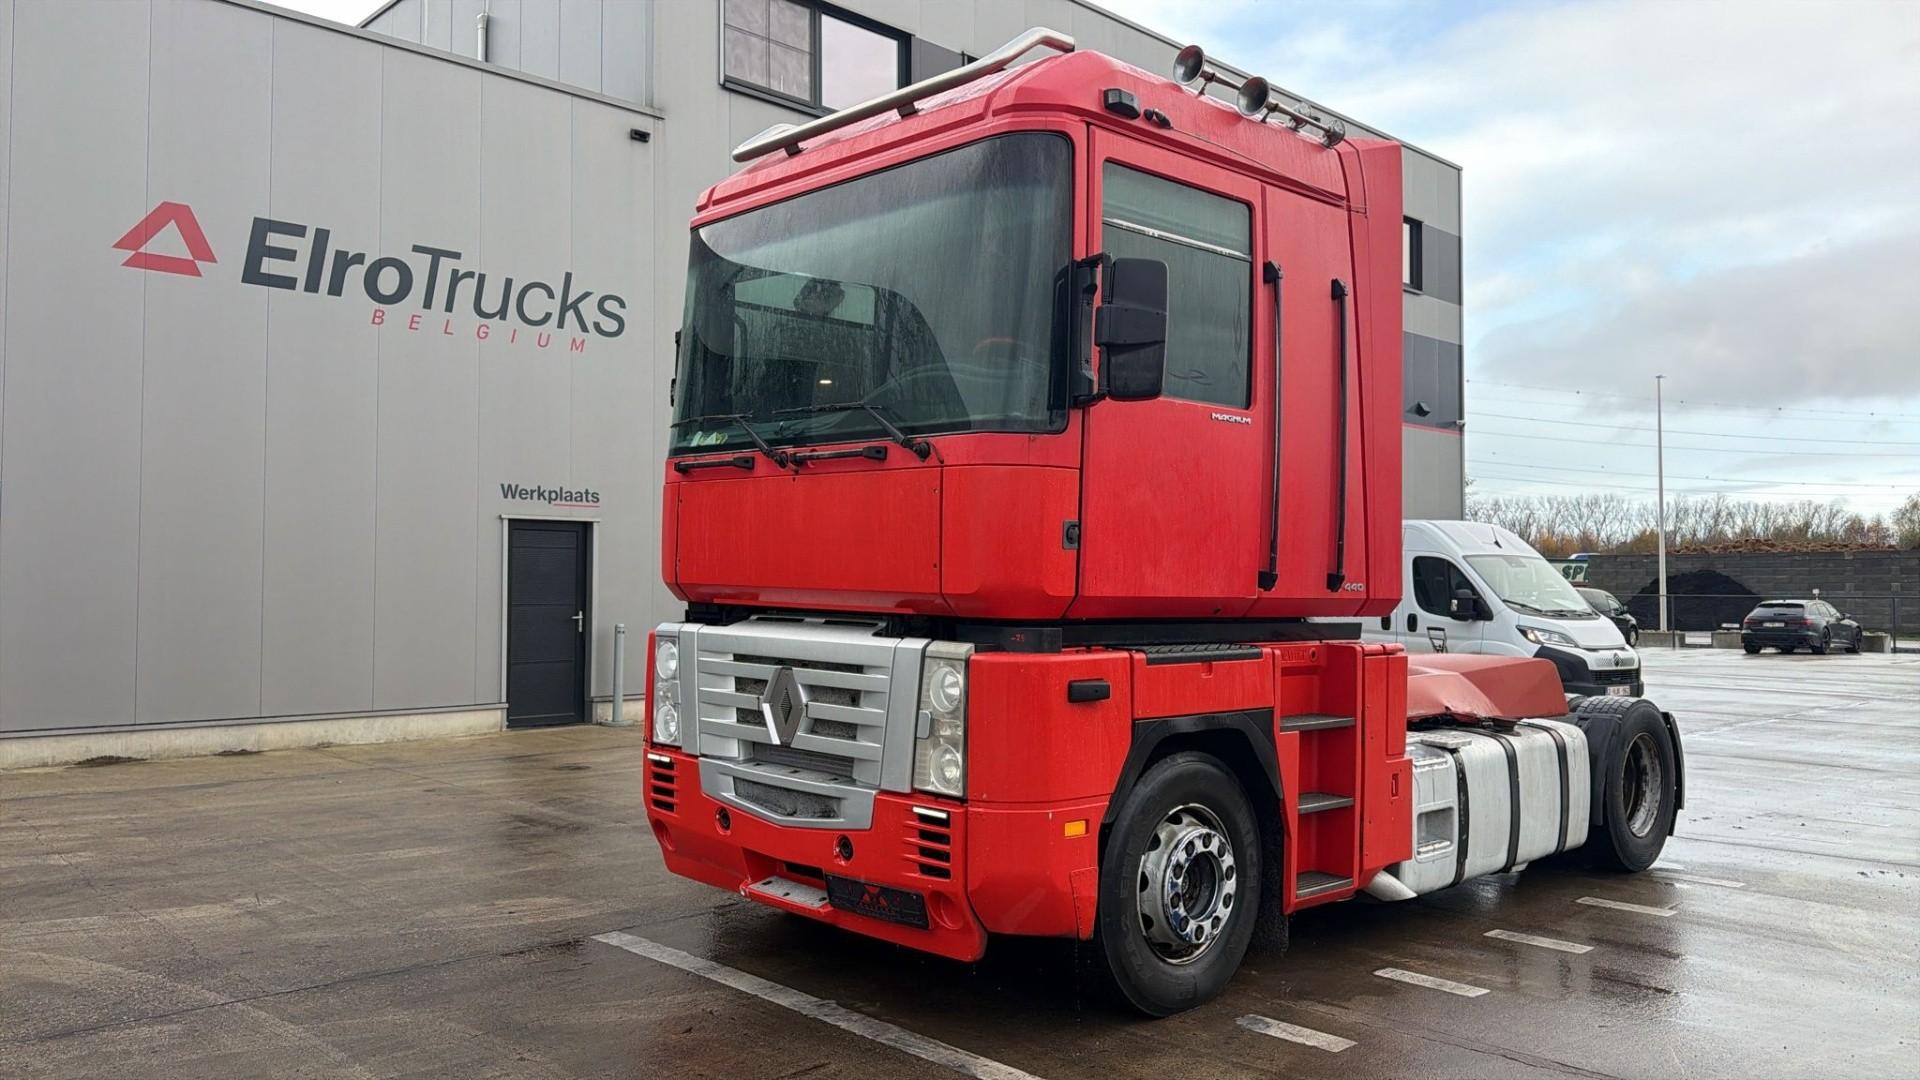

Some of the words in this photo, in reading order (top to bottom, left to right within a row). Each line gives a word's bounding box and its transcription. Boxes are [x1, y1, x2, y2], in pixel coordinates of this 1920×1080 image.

[240, 216, 627, 338] ElroTrucks
[371, 308, 586, 353] BELGIUM
[1211, 412, 1252, 425] MAGNUM
[500, 483, 600, 504] Werkplaats
[1343, 582, 1364, 592] 440
